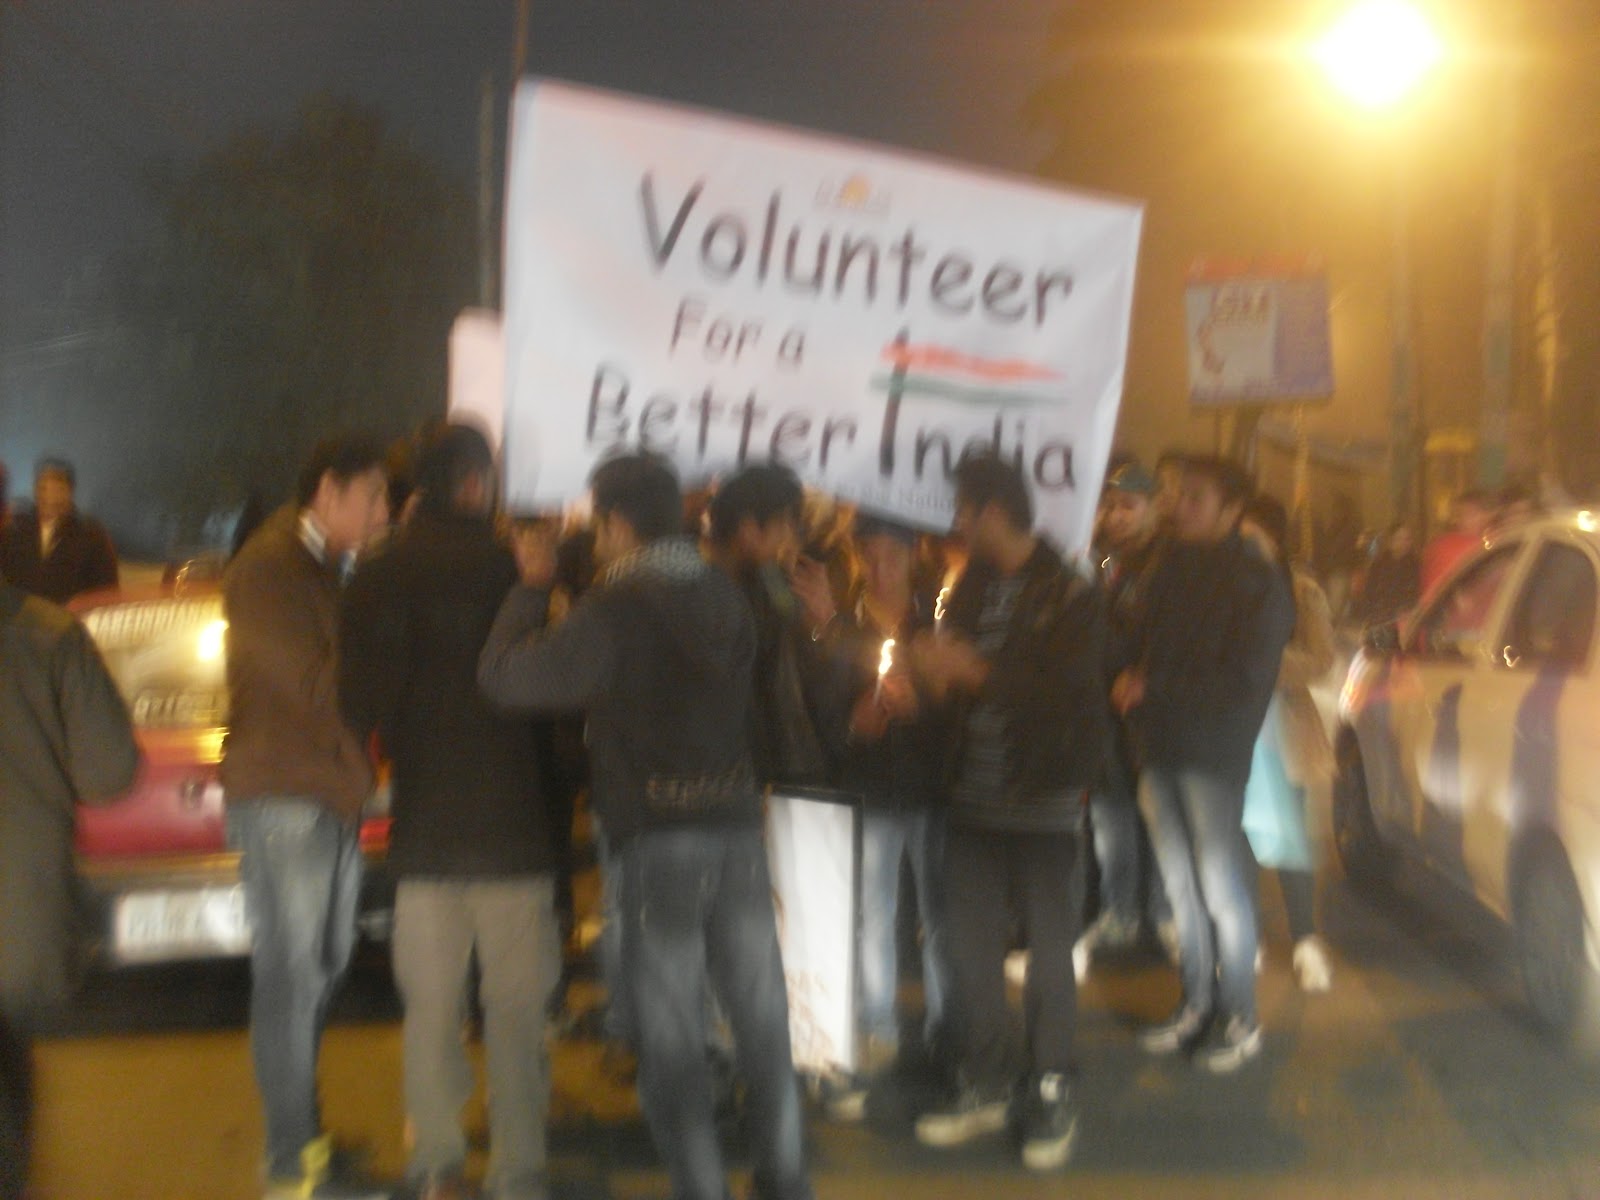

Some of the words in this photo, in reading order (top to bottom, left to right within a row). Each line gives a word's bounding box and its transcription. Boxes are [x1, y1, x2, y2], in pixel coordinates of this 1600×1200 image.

[638, 169, 1074, 330] Volunteer
[775, 324, 806, 369] a
[586, 362, 858, 468] Better
